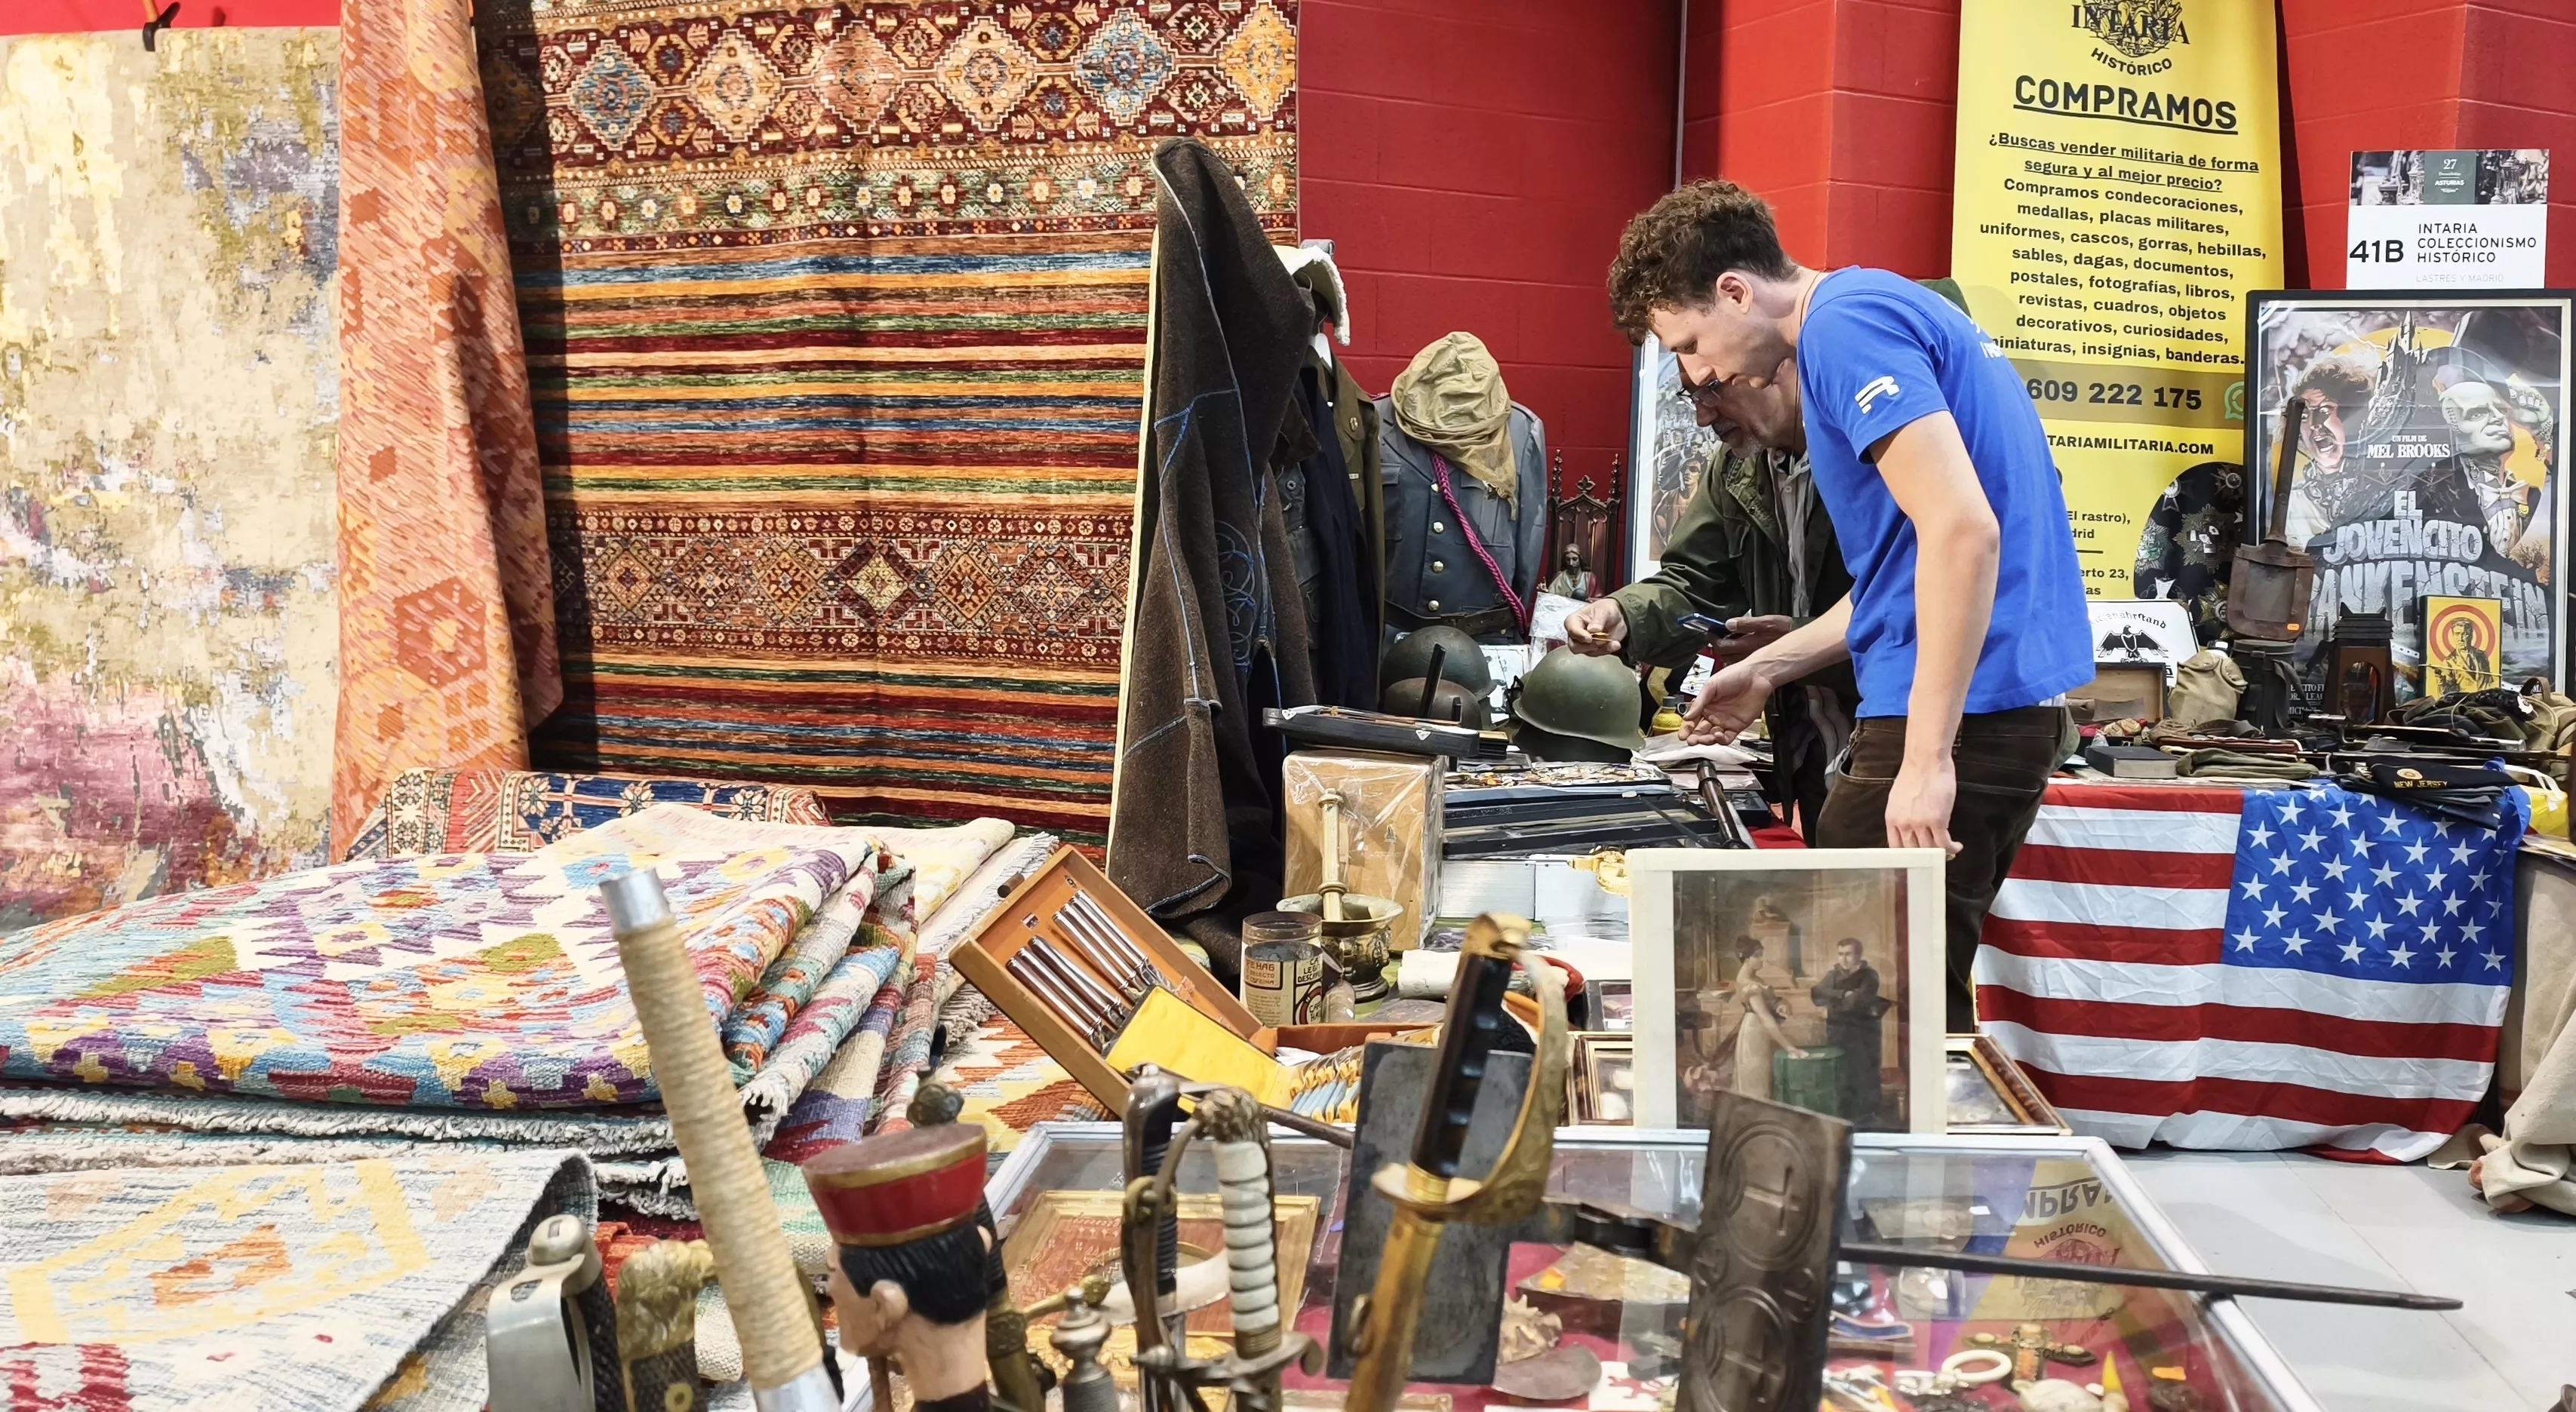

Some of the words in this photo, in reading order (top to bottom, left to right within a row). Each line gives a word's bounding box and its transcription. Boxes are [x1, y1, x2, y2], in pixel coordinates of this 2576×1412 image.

[2091, 48, 2173, 76] HISTÓRICO
[2014, 75, 2239, 131] COMPRAMOS
[1989, 132, 2055, 152] ¿Buscas
[2061, 141, 2116, 156] vender
[2121, 146, 2184, 166] militaria
[2189, 154, 2207, 167] de
[2211, 157, 2259, 172] forma
[2443, 158, 2458, 170] 27
[2024, 161, 2078, 180] segura
[2083, 168, 2093, 180] y
[2098, 165, 2113, 178] al
[2119, 168, 2162, 186] mejor
[2167, 174, 2223, 192] precio?
[2004, 178, 2100, 201] Compramos
[2104, 189, 2244, 216] condecoraciones,
[2017, 204, 2095, 223] medallas,
[2099, 210, 2152, 227] placas
[2156, 215, 2229, 238] militares,
[2418, 223, 2477, 234] INTARIA
[1980, 223, 2065, 244] uniformes,
[2070, 232, 2134, 249] cascos,
[2138, 236, 2193, 255] gorras,
[2197, 241, 2267, 260] hebillas,
[2349, 239, 2405, 262] 41B
[2418, 237, 2537, 249] COLECCIONISMO
[2012, 247, 2068, 266] sables,
[2073, 254, 2129, 272] dagas,
[2133, 258, 2234, 279] documentos,
[2417, 250, 2496, 263] HISTÓRICO
[2011, 270, 2083, 289] postales,
[2089, 275, 2181, 296] fotografías,
[2185, 284, 2236, 301] libros,
[2416, 275, 2457, 284] LASTRES
[2461, 275, 2467, 283] Y
[2469, 274, 2504, 283] MADRID
[2019, 293, 2088, 312] revistas,
[2093, 299, 2164, 318] cuadros,
[2169, 305, 2227, 321] objetos
[2016, 315, 2117, 336] decorativos,
[2123, 324, 2228, 345] curiosidades,
[2082, 342, 2161, 361] insignias,
[2166, 348, 2244, 365] banderas.
[2027, 379, 2078, 402] 609
[2089, 383, 2143, 406] 222
[2153, 388, 2202, 410] 175
[2047, 435, 2214, 455] TARIAMILITARIA.COM
[2366, 444, 2394, 458] MEL
[2397, 444, 2451, 458] BROOKS
[2394, 490, 2424, 520] EL
[2082, 513, 2130, 525] rastro),
[2322, 519, 2484, 566] JOVENCITO
[2109, 569, 2129, 582] 23,
[2083, 585, 2101, 595] as
[2393, 780, 2414, 788] NEW
[2417, 780, 2448, 788] JERSEY
[1256, 962, 1275, 972] HAG
